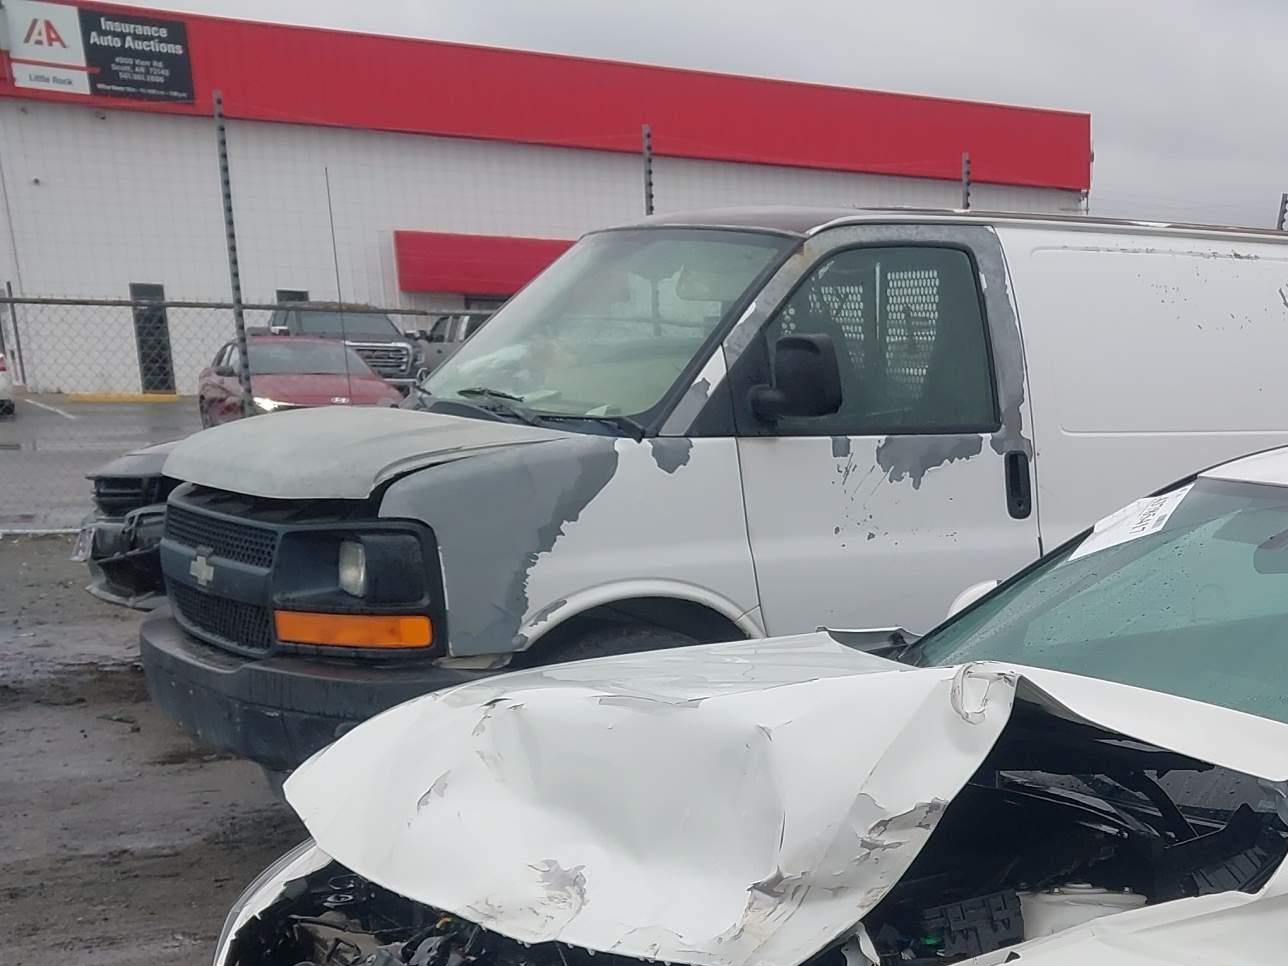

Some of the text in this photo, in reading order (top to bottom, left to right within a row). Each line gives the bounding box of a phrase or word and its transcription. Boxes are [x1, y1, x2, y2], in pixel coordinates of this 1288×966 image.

[100, 17, 168, 37] Insurance
[90, 31, 183, 54] Auto Auctions
